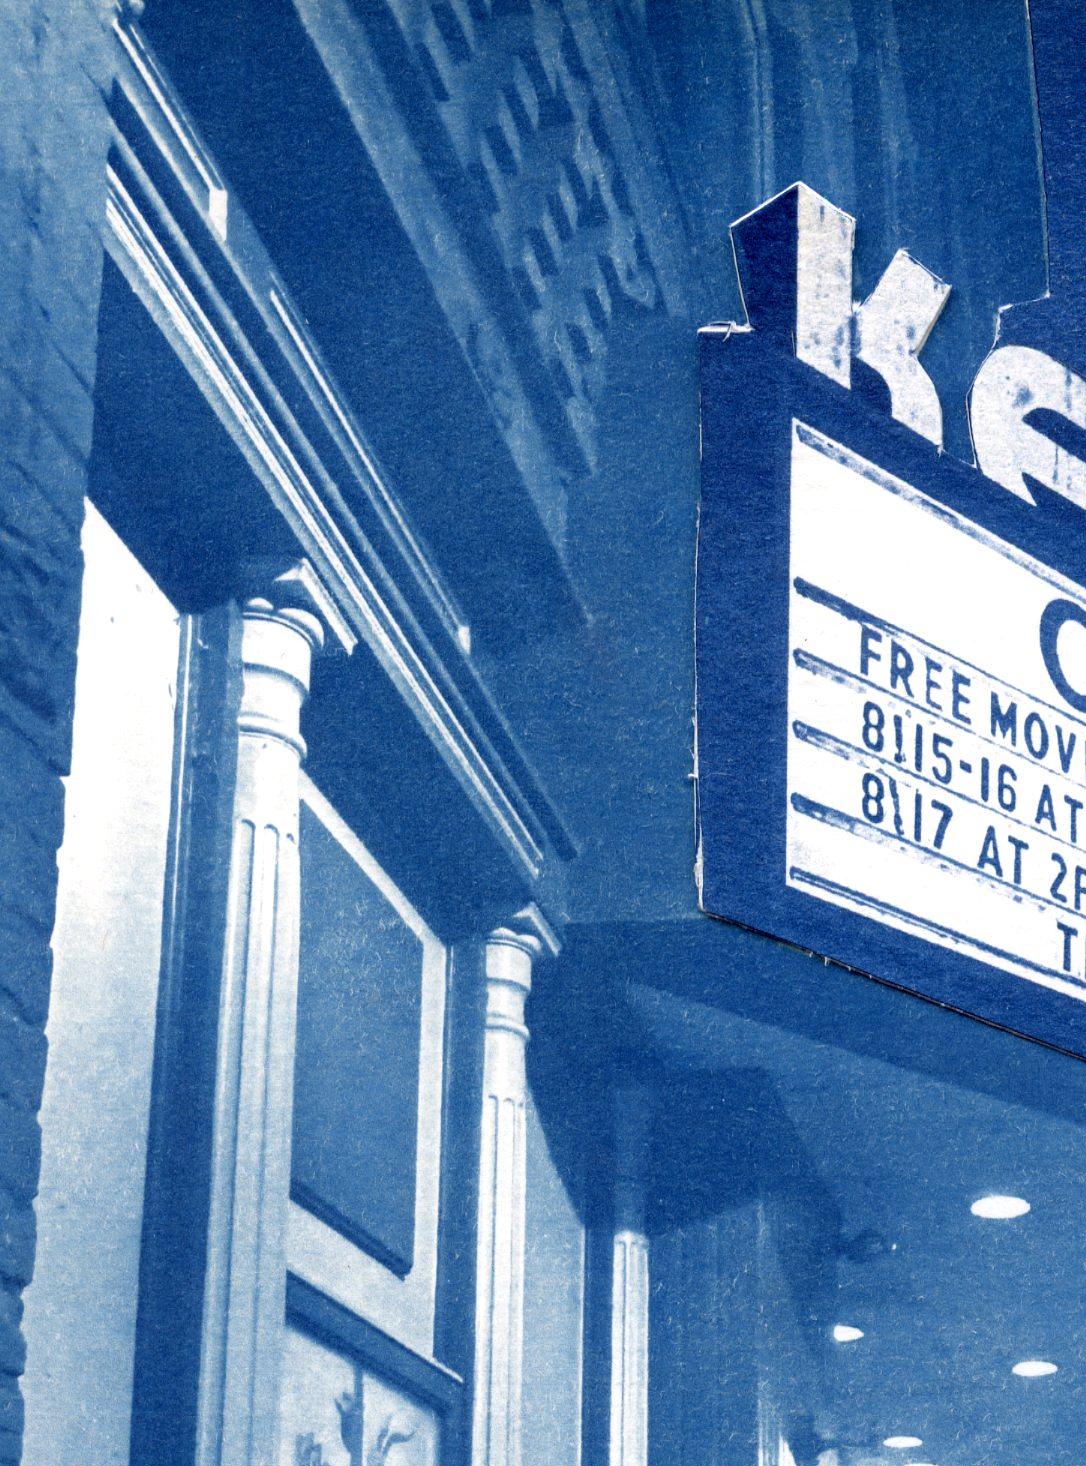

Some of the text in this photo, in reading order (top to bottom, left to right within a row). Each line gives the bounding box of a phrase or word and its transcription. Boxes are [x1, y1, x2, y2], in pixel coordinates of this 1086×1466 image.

[860, 625, 971, 724] FREE
[1036, 785, 1084, 844] AT
[978, 826, 1029, 885] AT
